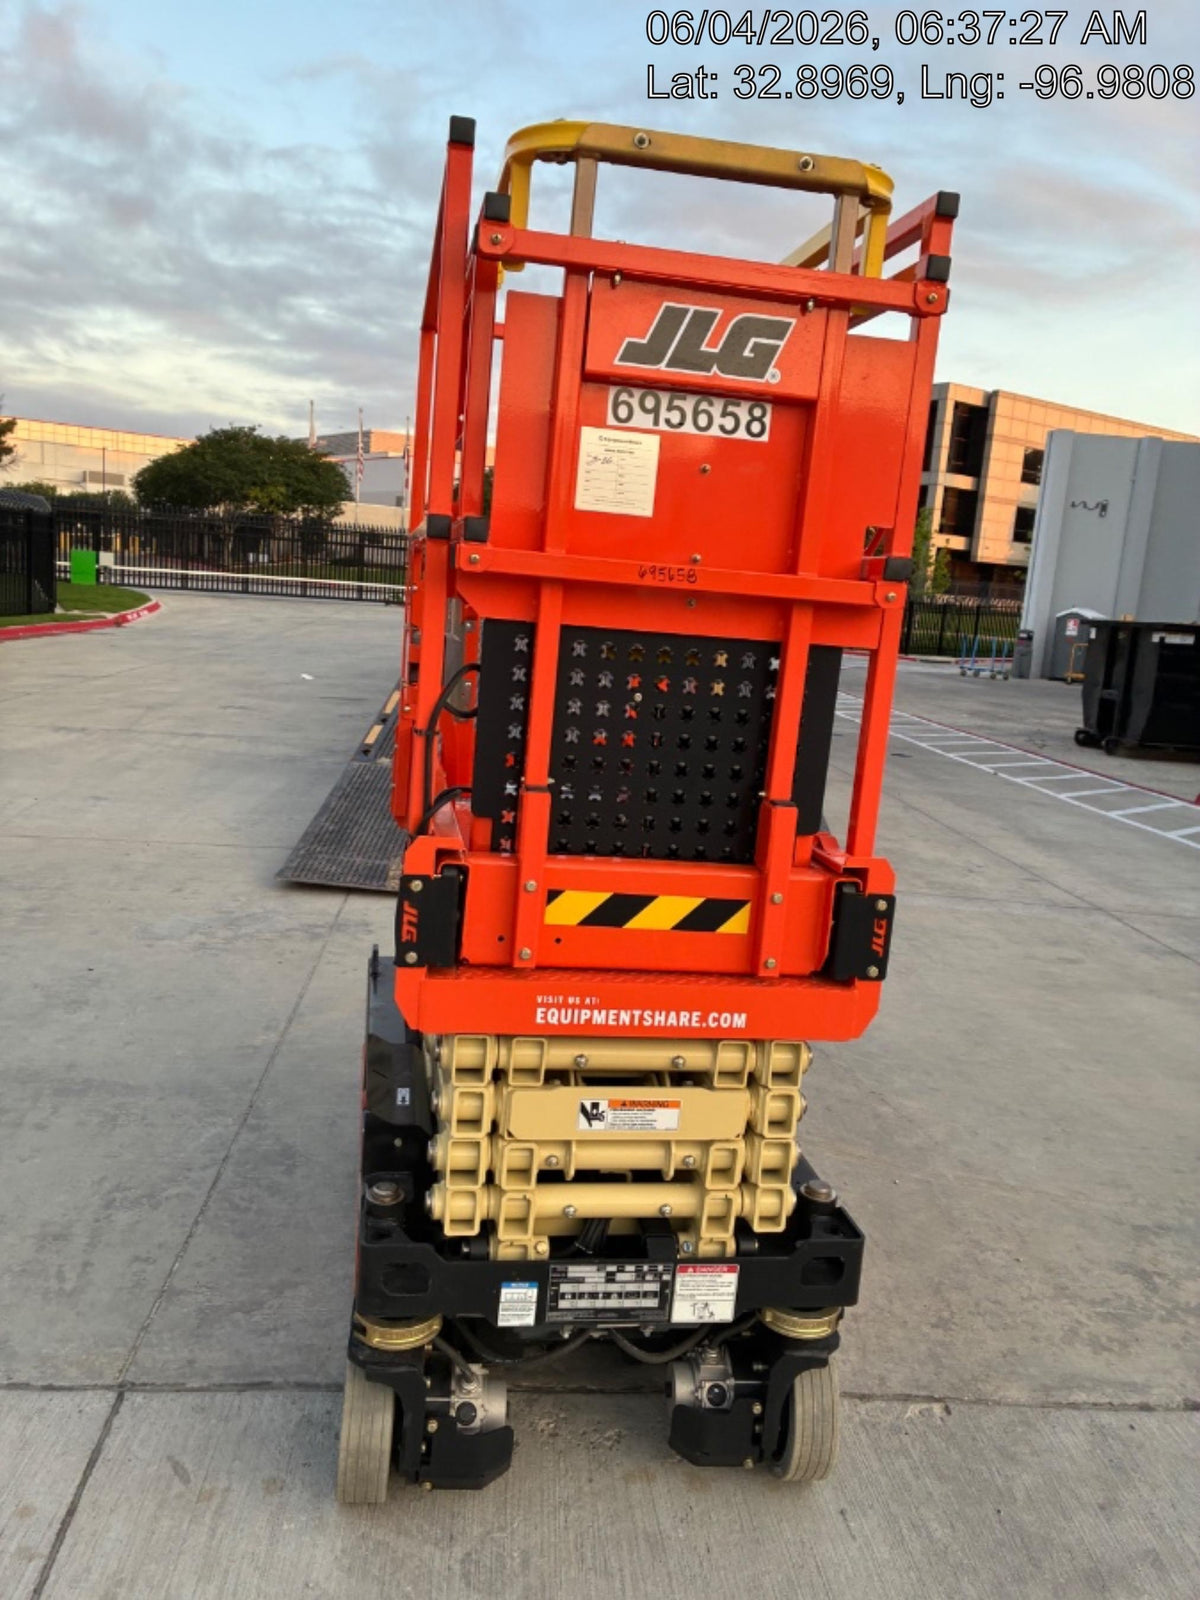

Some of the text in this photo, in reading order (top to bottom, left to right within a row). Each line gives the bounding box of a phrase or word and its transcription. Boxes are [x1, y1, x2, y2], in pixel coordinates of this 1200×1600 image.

[614, 302, 797, 382] JLG
[611, 387, 767, 438] 695658
[638, 565, 698, 584] 695658
[402, 900, 418, 943] JLG
[872, 918, 887, 957] JLG
[536, 995, 564, 1004] VISIT
[568, 996, 581, 1005] US
[536, 1007, 748, 1029] EQUIPMENTSHARE.COM
